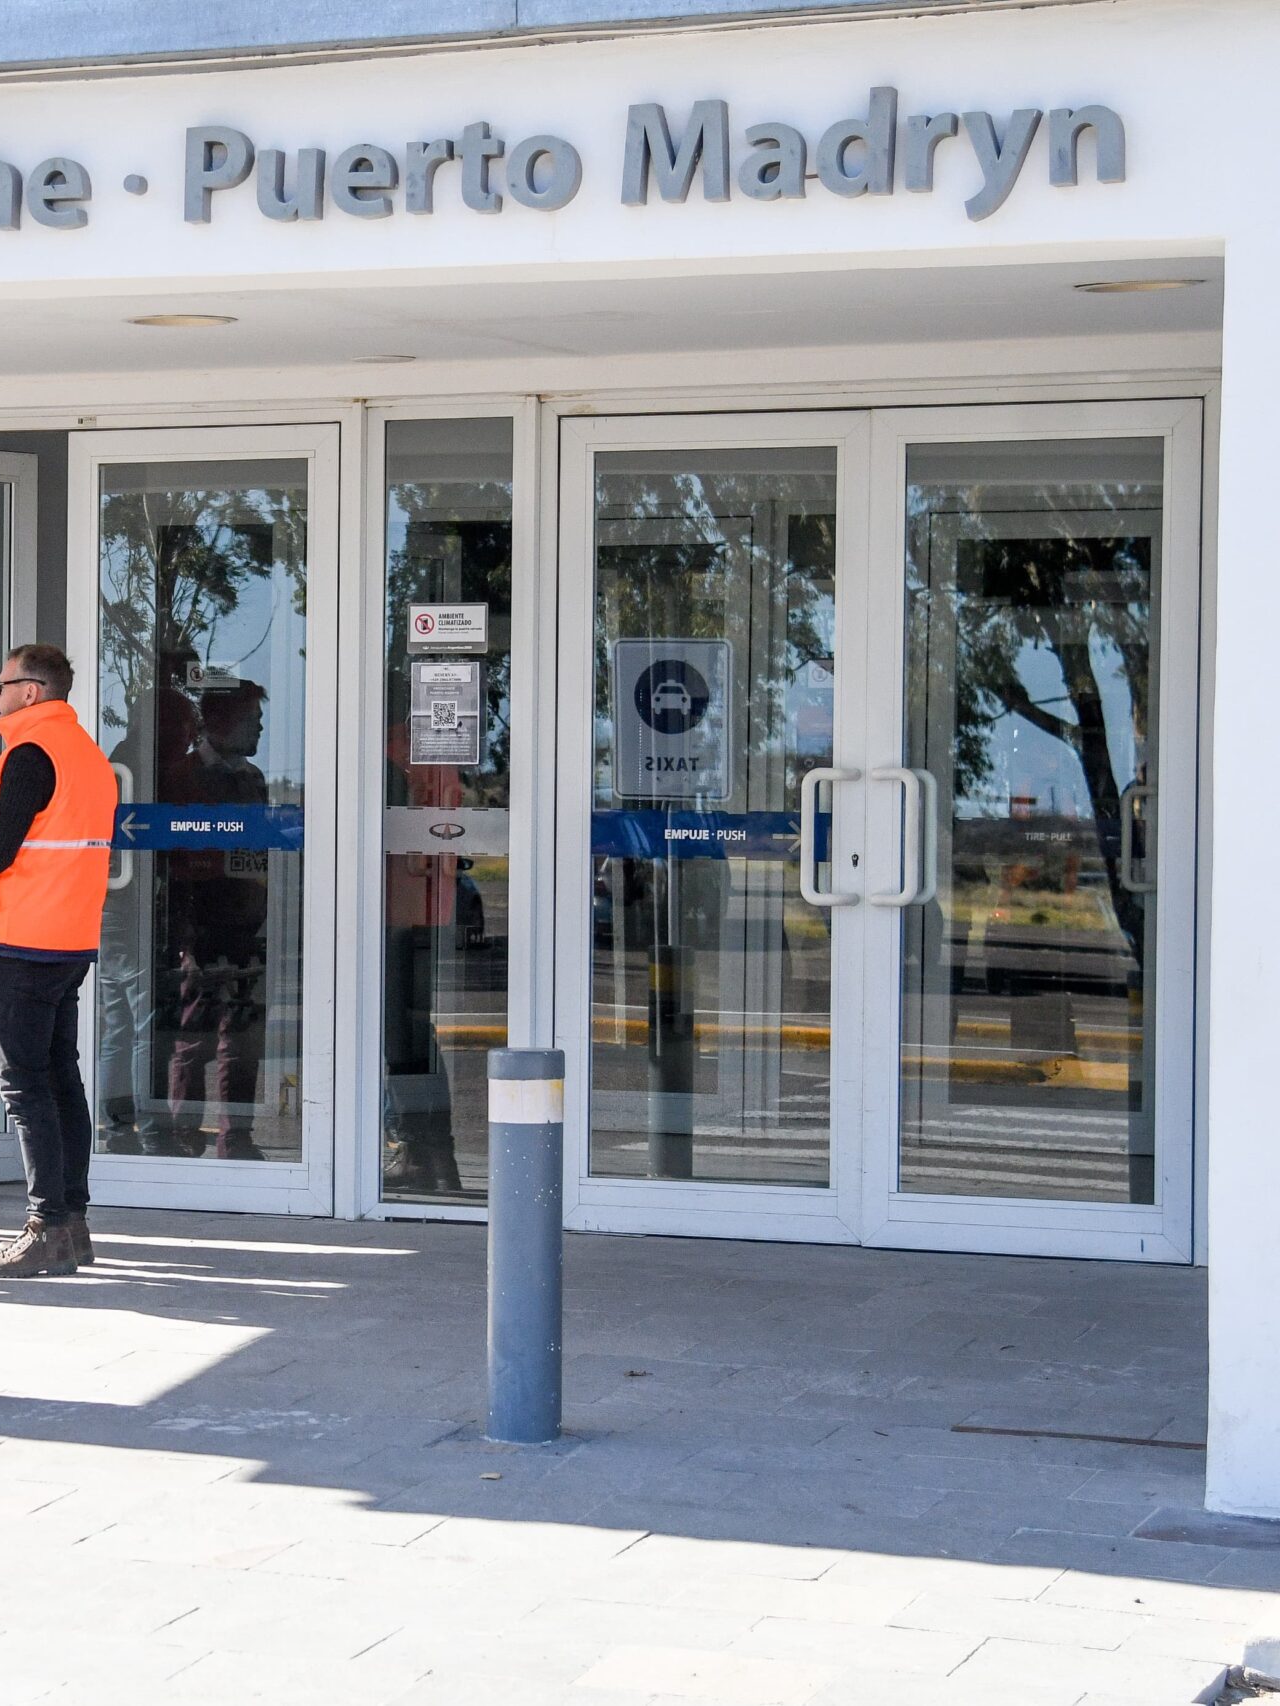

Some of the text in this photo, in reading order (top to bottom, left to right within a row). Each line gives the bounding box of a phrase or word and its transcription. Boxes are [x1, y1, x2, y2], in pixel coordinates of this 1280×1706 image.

[184, 120, 582, 224] Puerto
[621, 87, 1126, 222] Madryn
[170, 821, 243, 832] EMPUJE PUSH
[664, 828, 746, 841] EMPUJE PUSH
[1024, 832, 1072, 841] TIRE PULL
